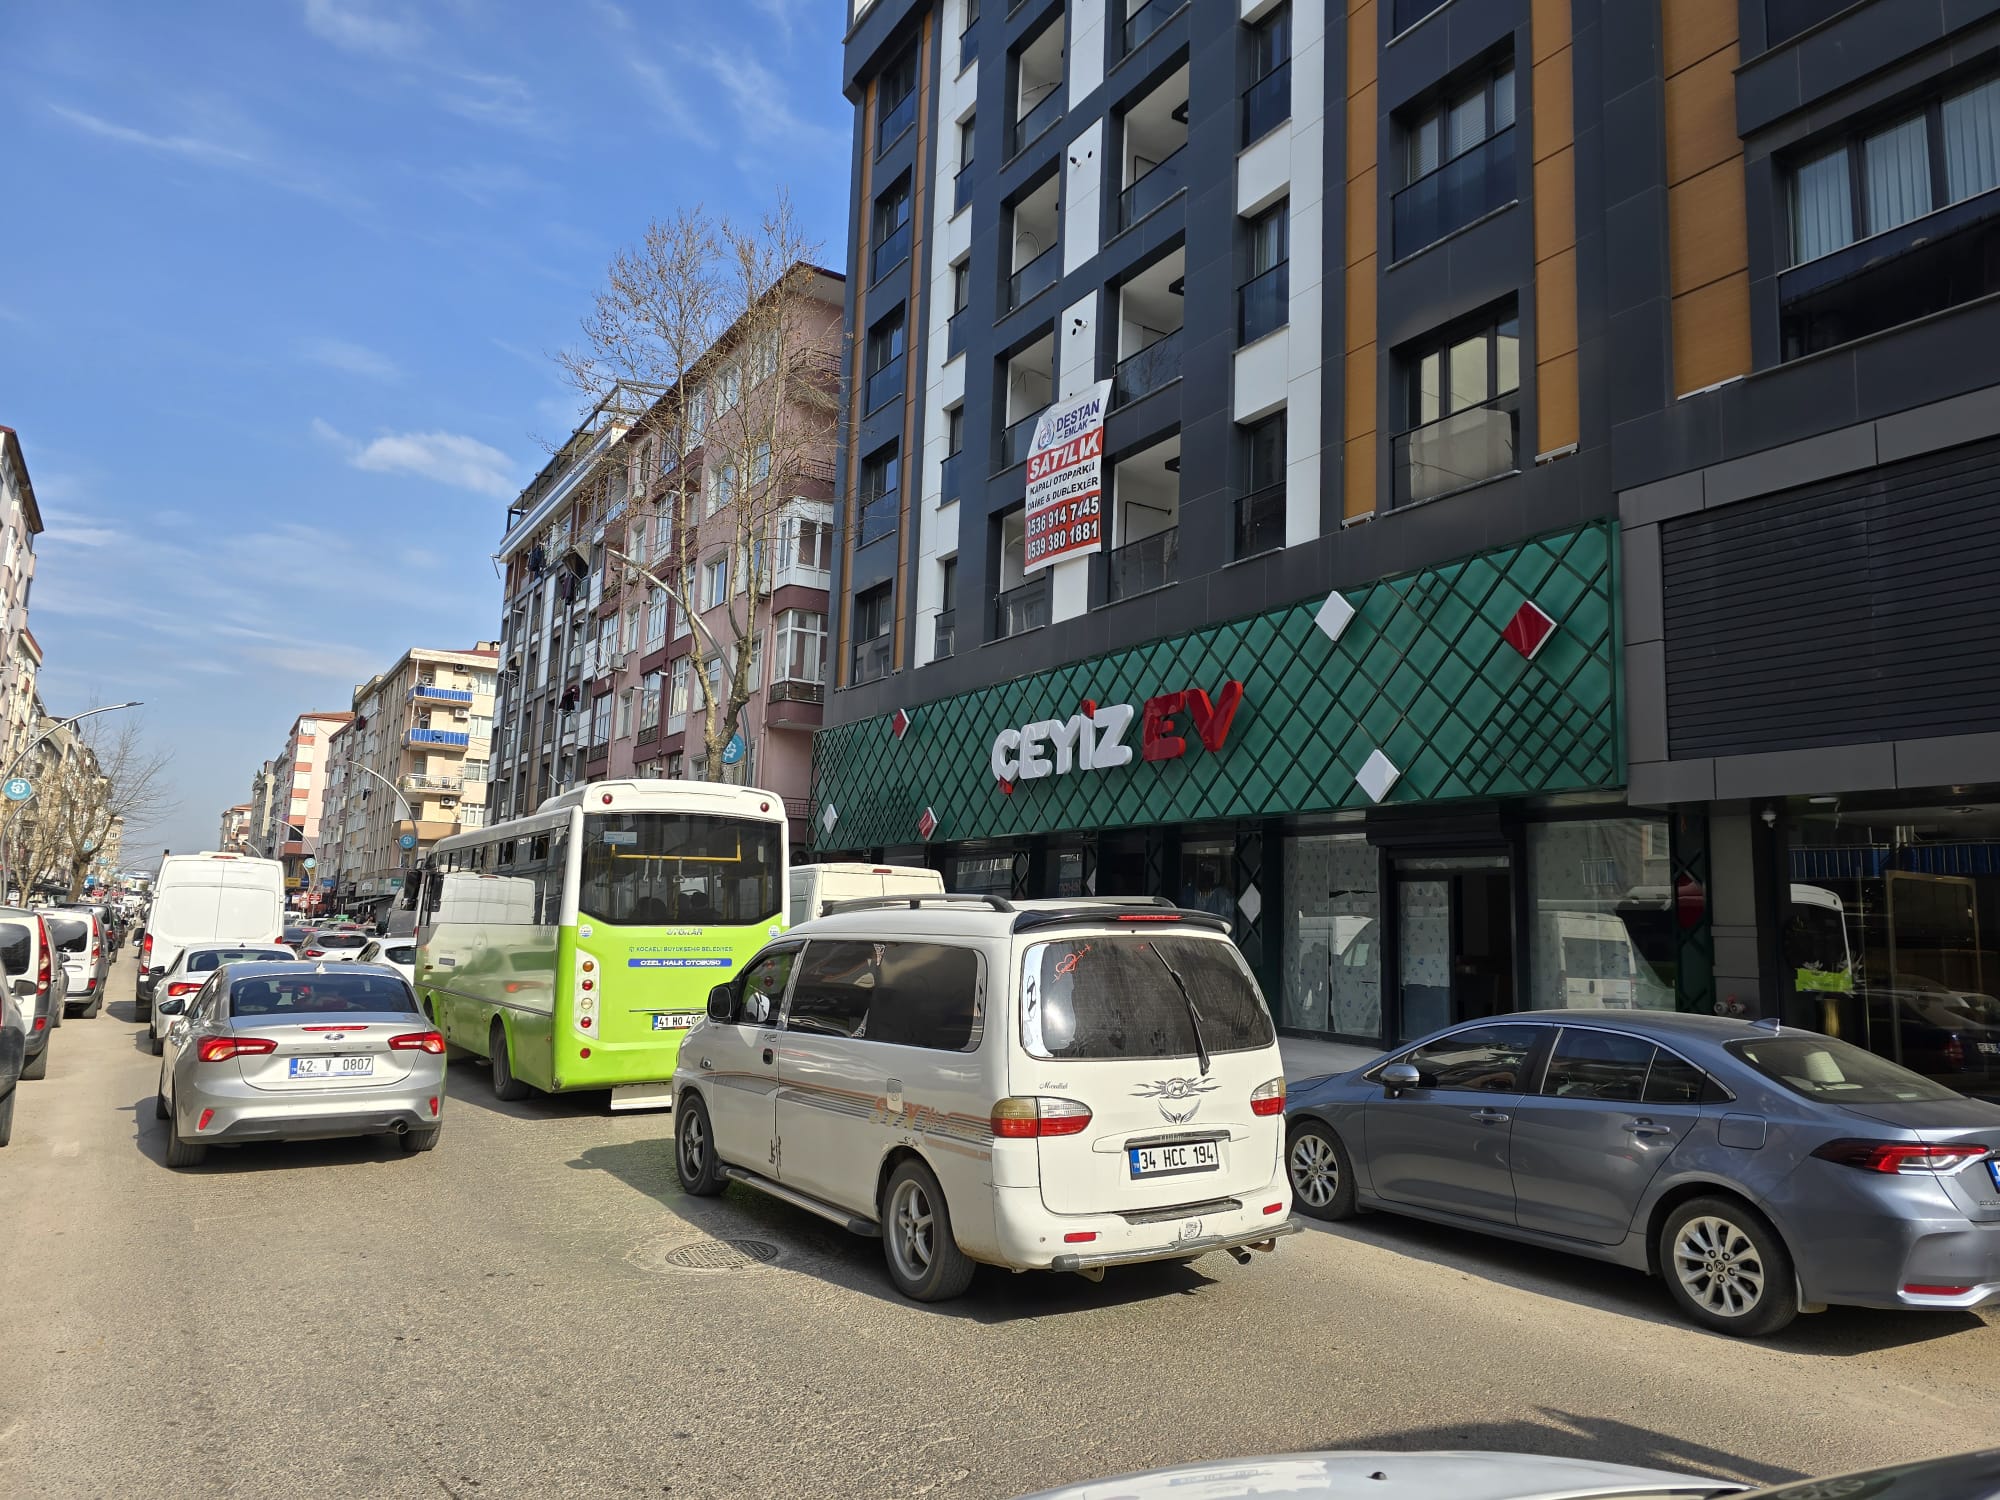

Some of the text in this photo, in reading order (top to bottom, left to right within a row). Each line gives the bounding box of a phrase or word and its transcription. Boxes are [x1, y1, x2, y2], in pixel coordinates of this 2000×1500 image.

[1056, 399, 1100, 432] DESTAN
[1063, 419, 1088, 439] EMLAK
[1030, 430, 1100, 480] SATILIK
[1029, 462, 1095, 496] KAPALI OTOPARKLI
[1027, 496, 1099, 538] 0536 914 7445
[1027, 520, 1098, 560] 0539 380 1881
[991, 680, 1243, 795] ÇEYİZ EV
[659, 1017, 669, 1026] 41
[299, 1060, 313, 1073] 42
[325, 1059, 331, 1072] V
[342, 1058, 372, 1071] 0807
[1140, 1151, 1157, 1170] 34
[1163, 1148, 1187, 1168] HCC
[1193, 1144, 1214, 1165] 194
